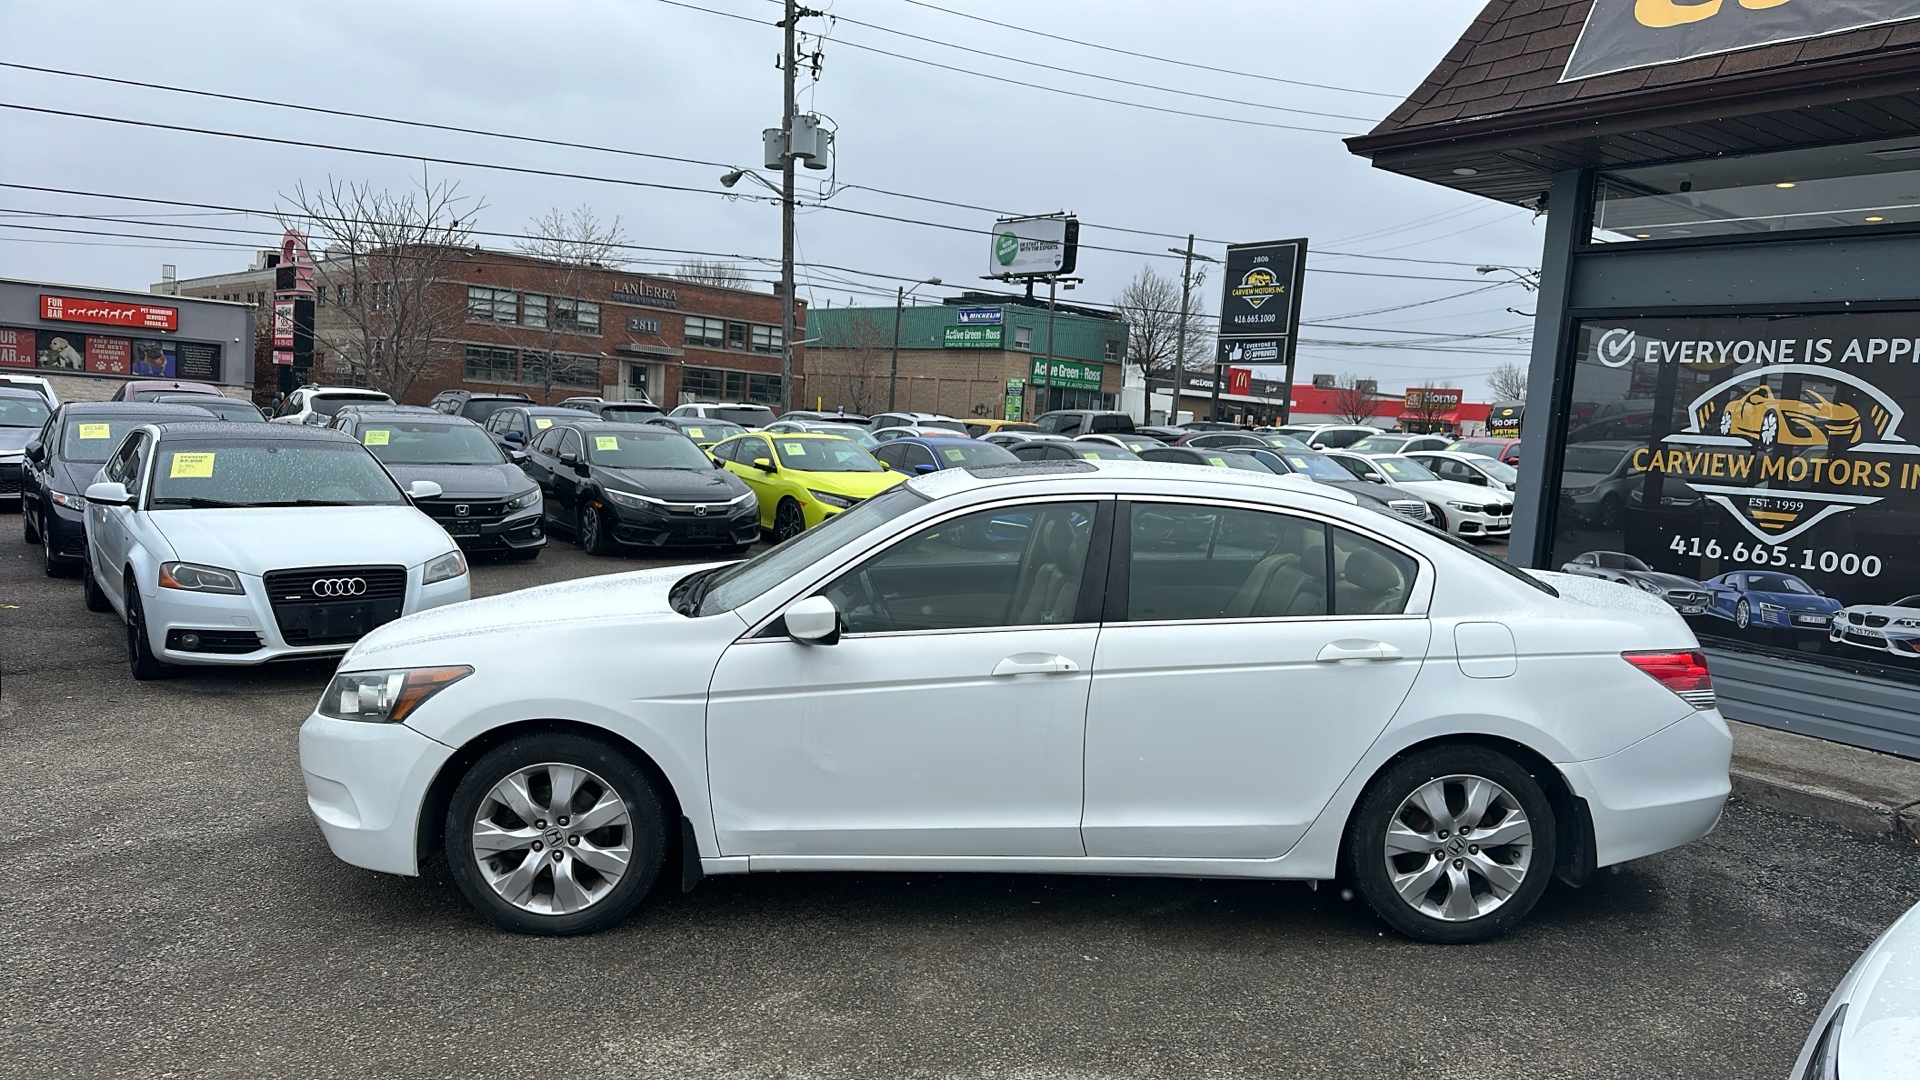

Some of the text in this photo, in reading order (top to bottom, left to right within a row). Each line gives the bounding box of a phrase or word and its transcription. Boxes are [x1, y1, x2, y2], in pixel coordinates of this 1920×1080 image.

[1252, 255, 1269, 263] 2806
[1232, 285, 1285, 296] CARVIEW MOTORS INC
[47, 297, 63, 308] FUR
[47, 308, 63, 319] BAR
[969, 312, 1001, 320] MICHELIN
[1234, 314, 1276, 323] 416.665.1000
[632, 318, 657, 332] 2811
[944, 329, 964, 340] Active
[1252, 349, 1276, 358] APPROVED
[1644, 338, 1795, 364] EVERYONE
[1803, 337, 1833, 363] IS
[1034, 361, 1058, 377] Actve
[1423, 391, 1458, 404] Home
[1503, 418, 1519, 426] OFF
[1632, 448, 1755, 479] CARVIEW
[1760, 454, 1891, 488] MOTORS
[1748, 497, 1804, 511] EST. 1999
[1670, 534, 1882, 578] 416.665.1000
